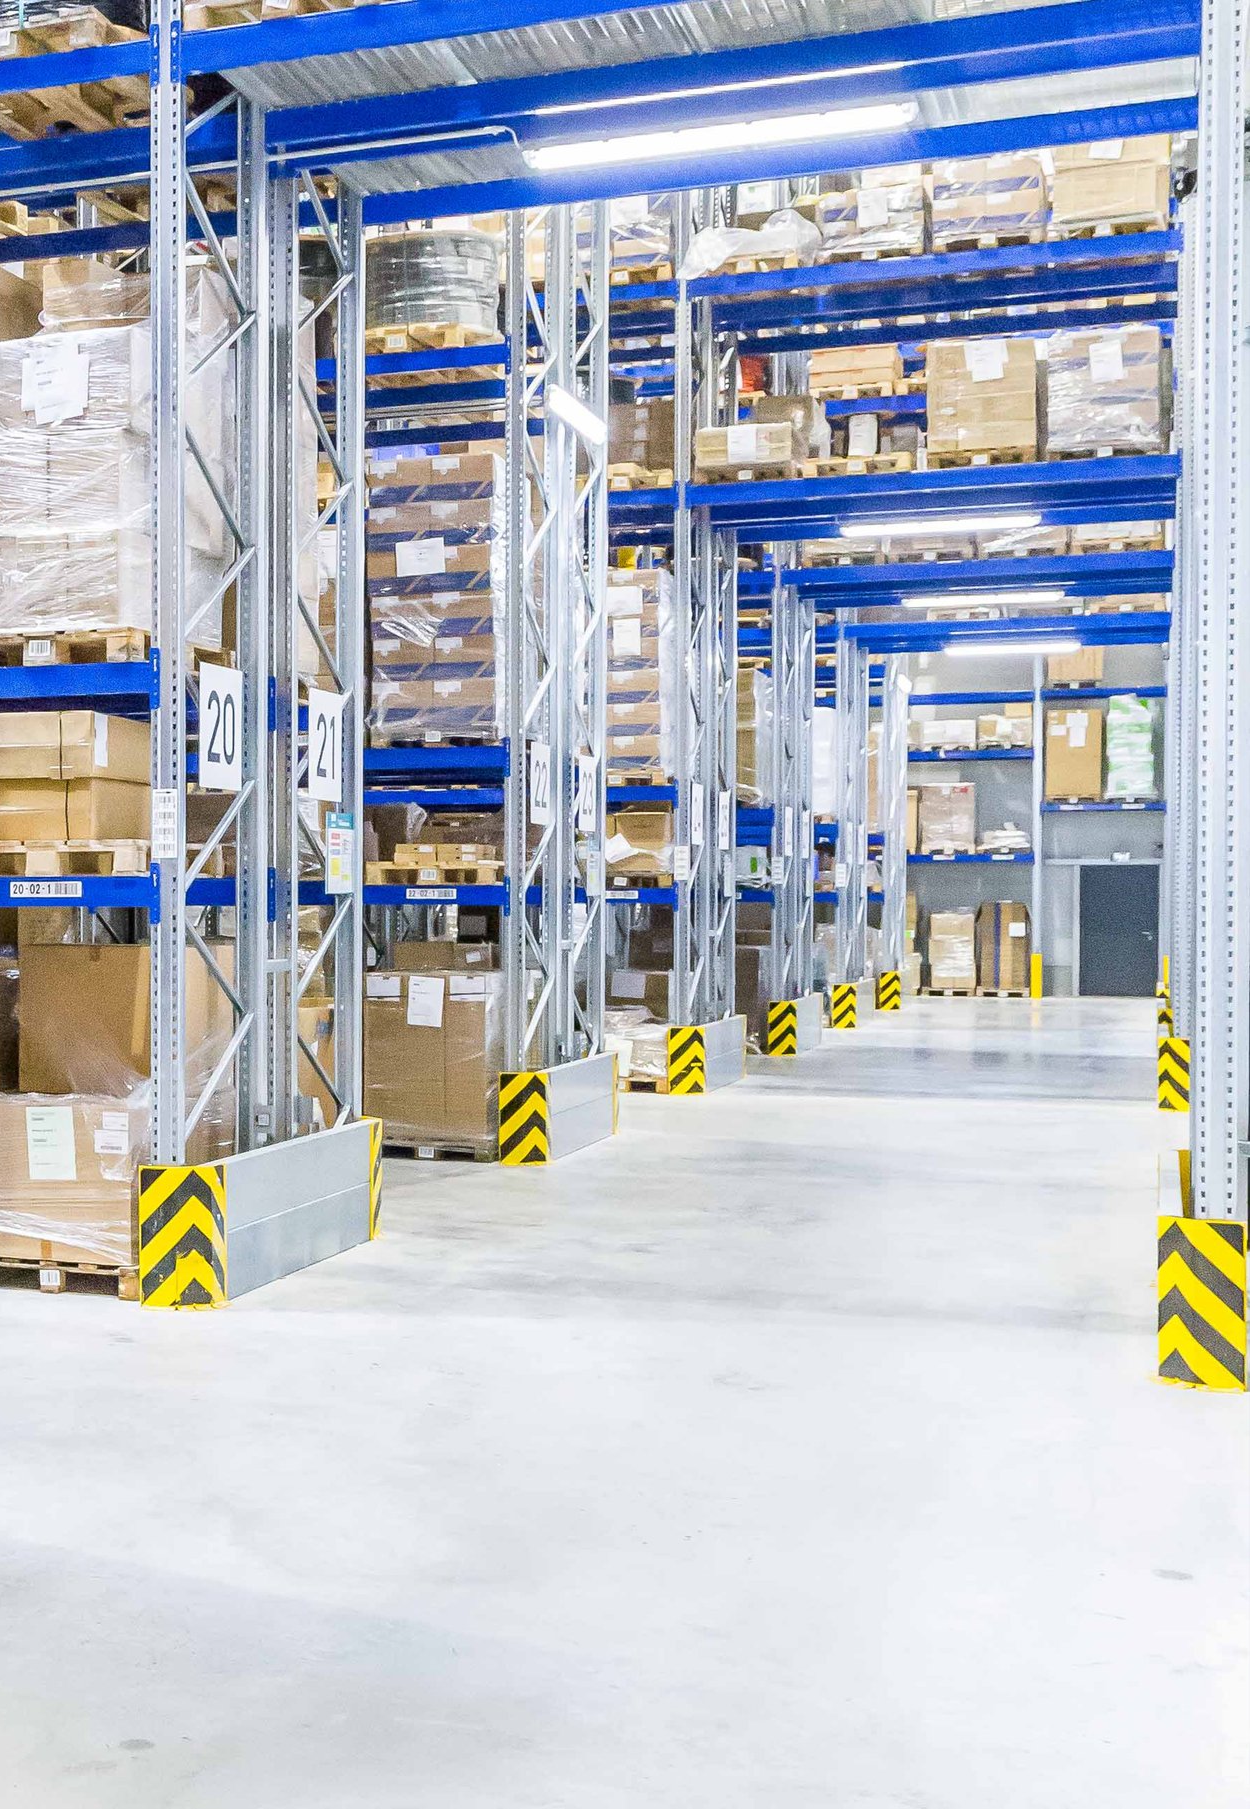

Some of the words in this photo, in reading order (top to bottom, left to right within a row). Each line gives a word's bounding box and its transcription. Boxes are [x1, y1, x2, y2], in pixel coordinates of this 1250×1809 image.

[207, 690, 235, 765] 20
[316, 713, 336, 780] 21
[535, 760, 547, 808] 22
[582, 771, 593, 816] 23
[13, 883, 51, 895] 20-02-1
